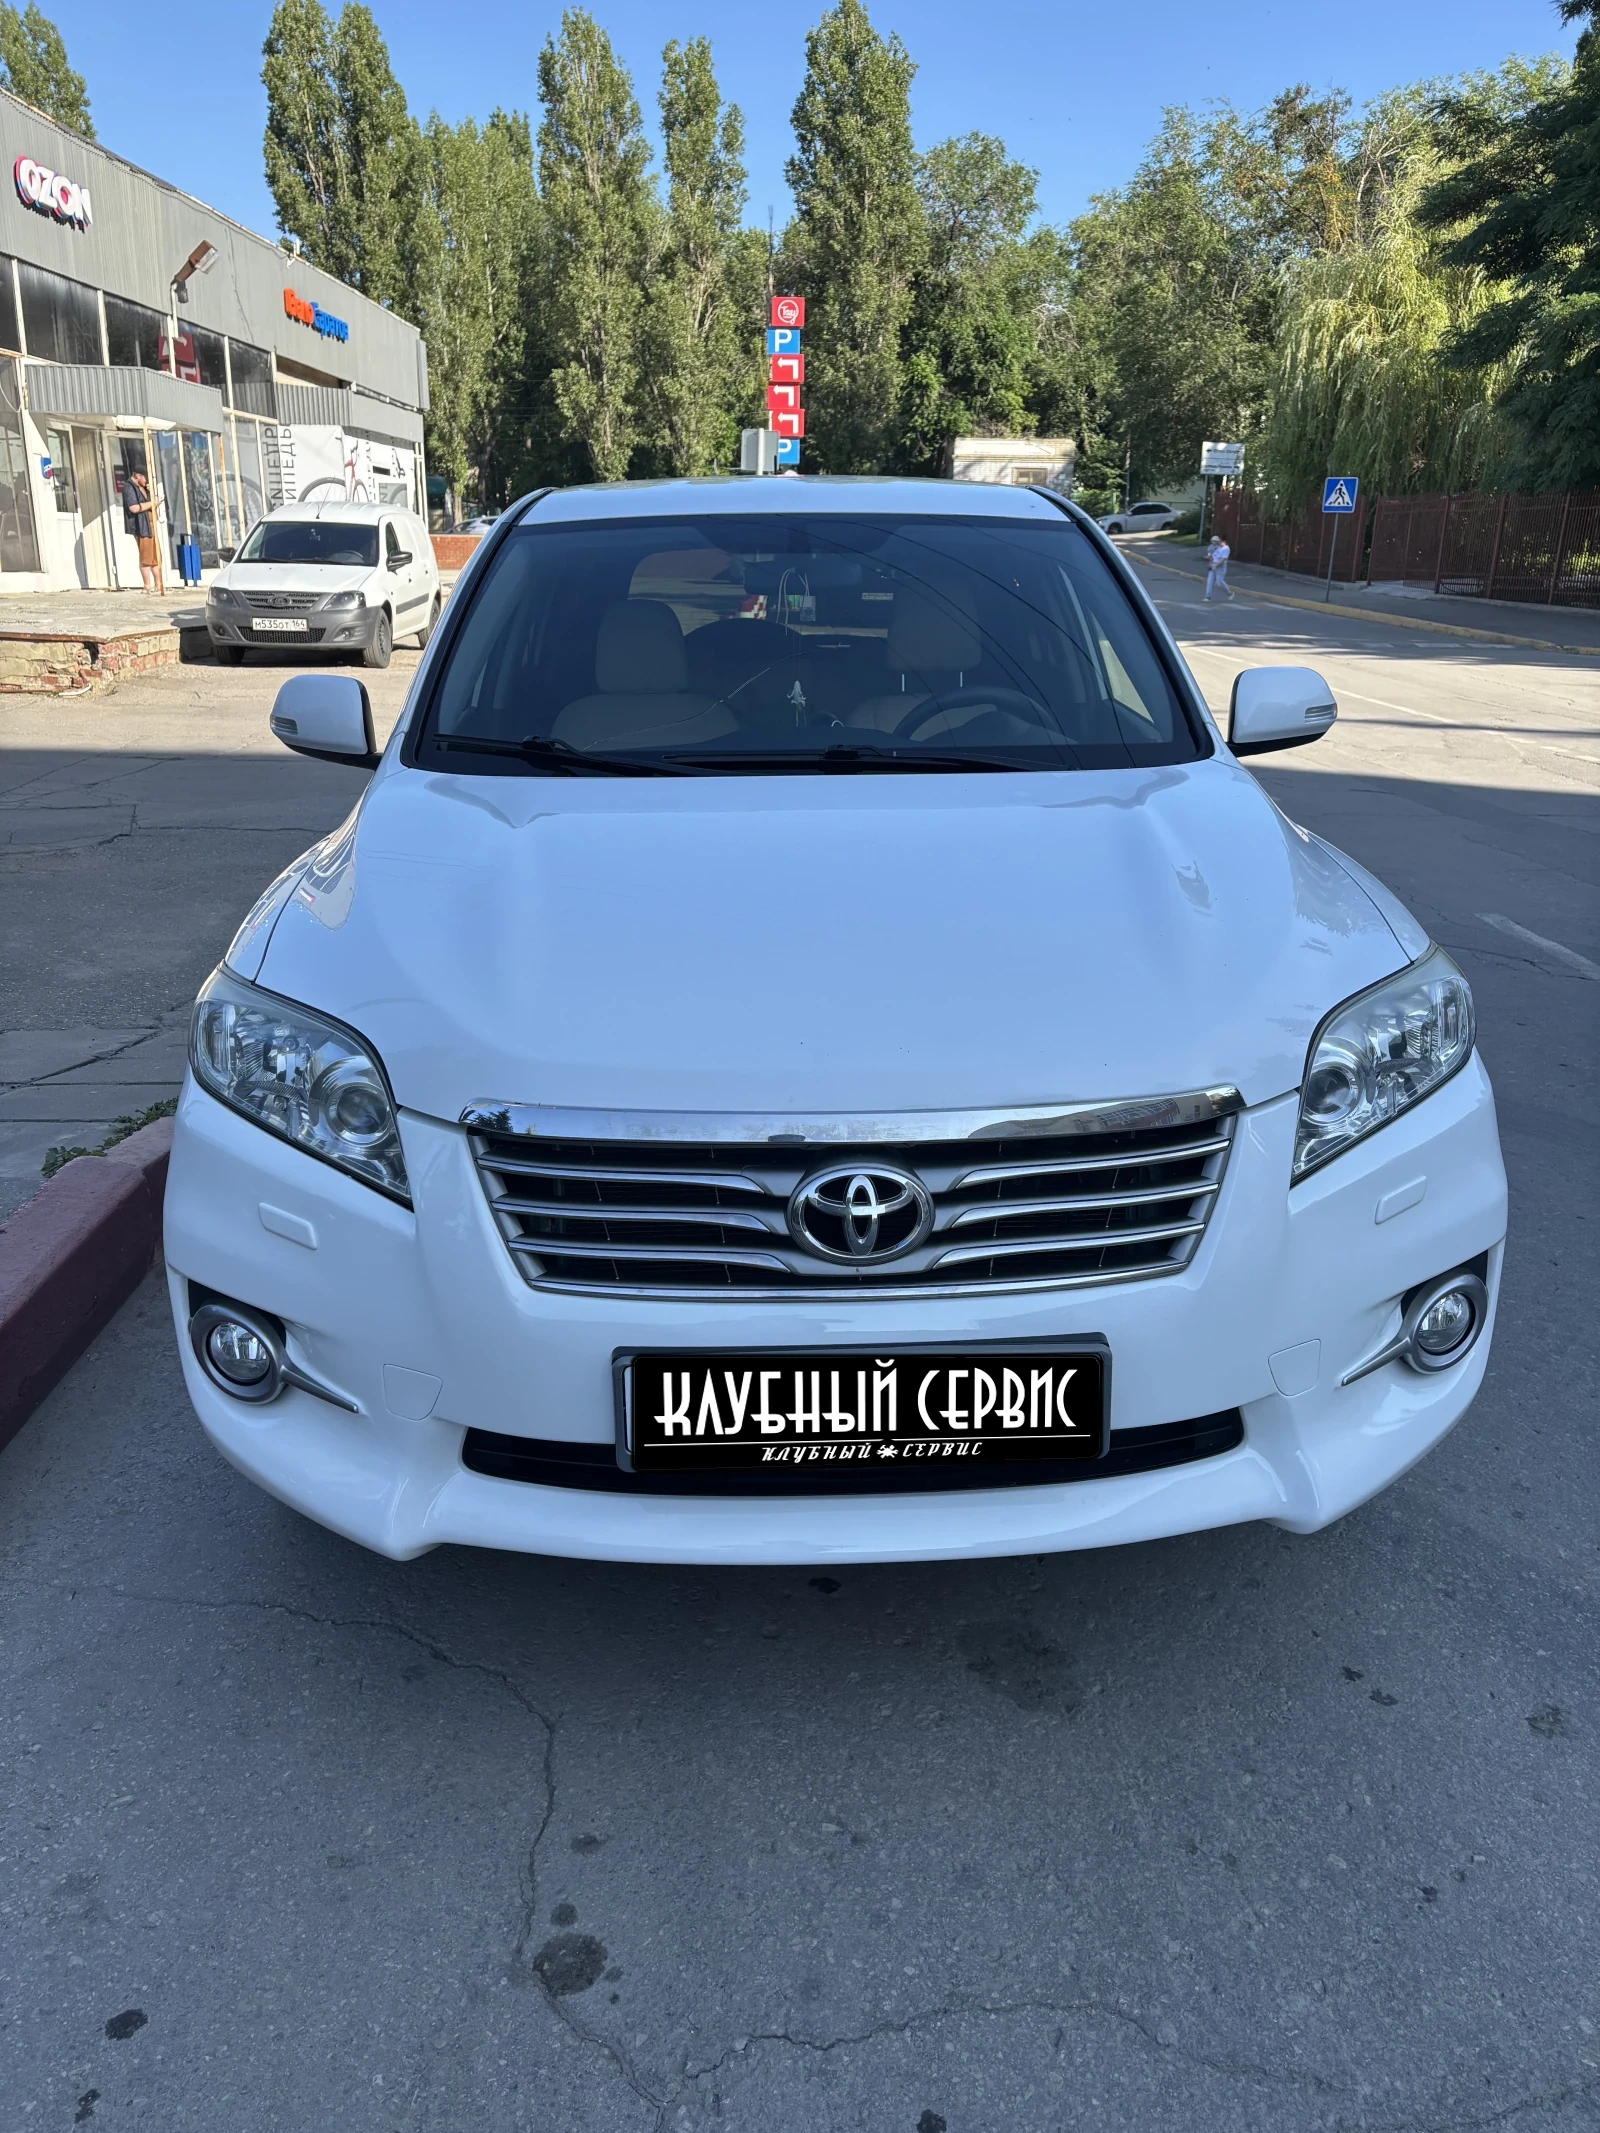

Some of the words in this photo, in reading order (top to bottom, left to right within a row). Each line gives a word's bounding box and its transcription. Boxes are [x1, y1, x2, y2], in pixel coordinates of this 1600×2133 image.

[17, 157, 94, 226] OZON
[774, 329, 792, 353] P
[292, 619, 305, 628] 164
